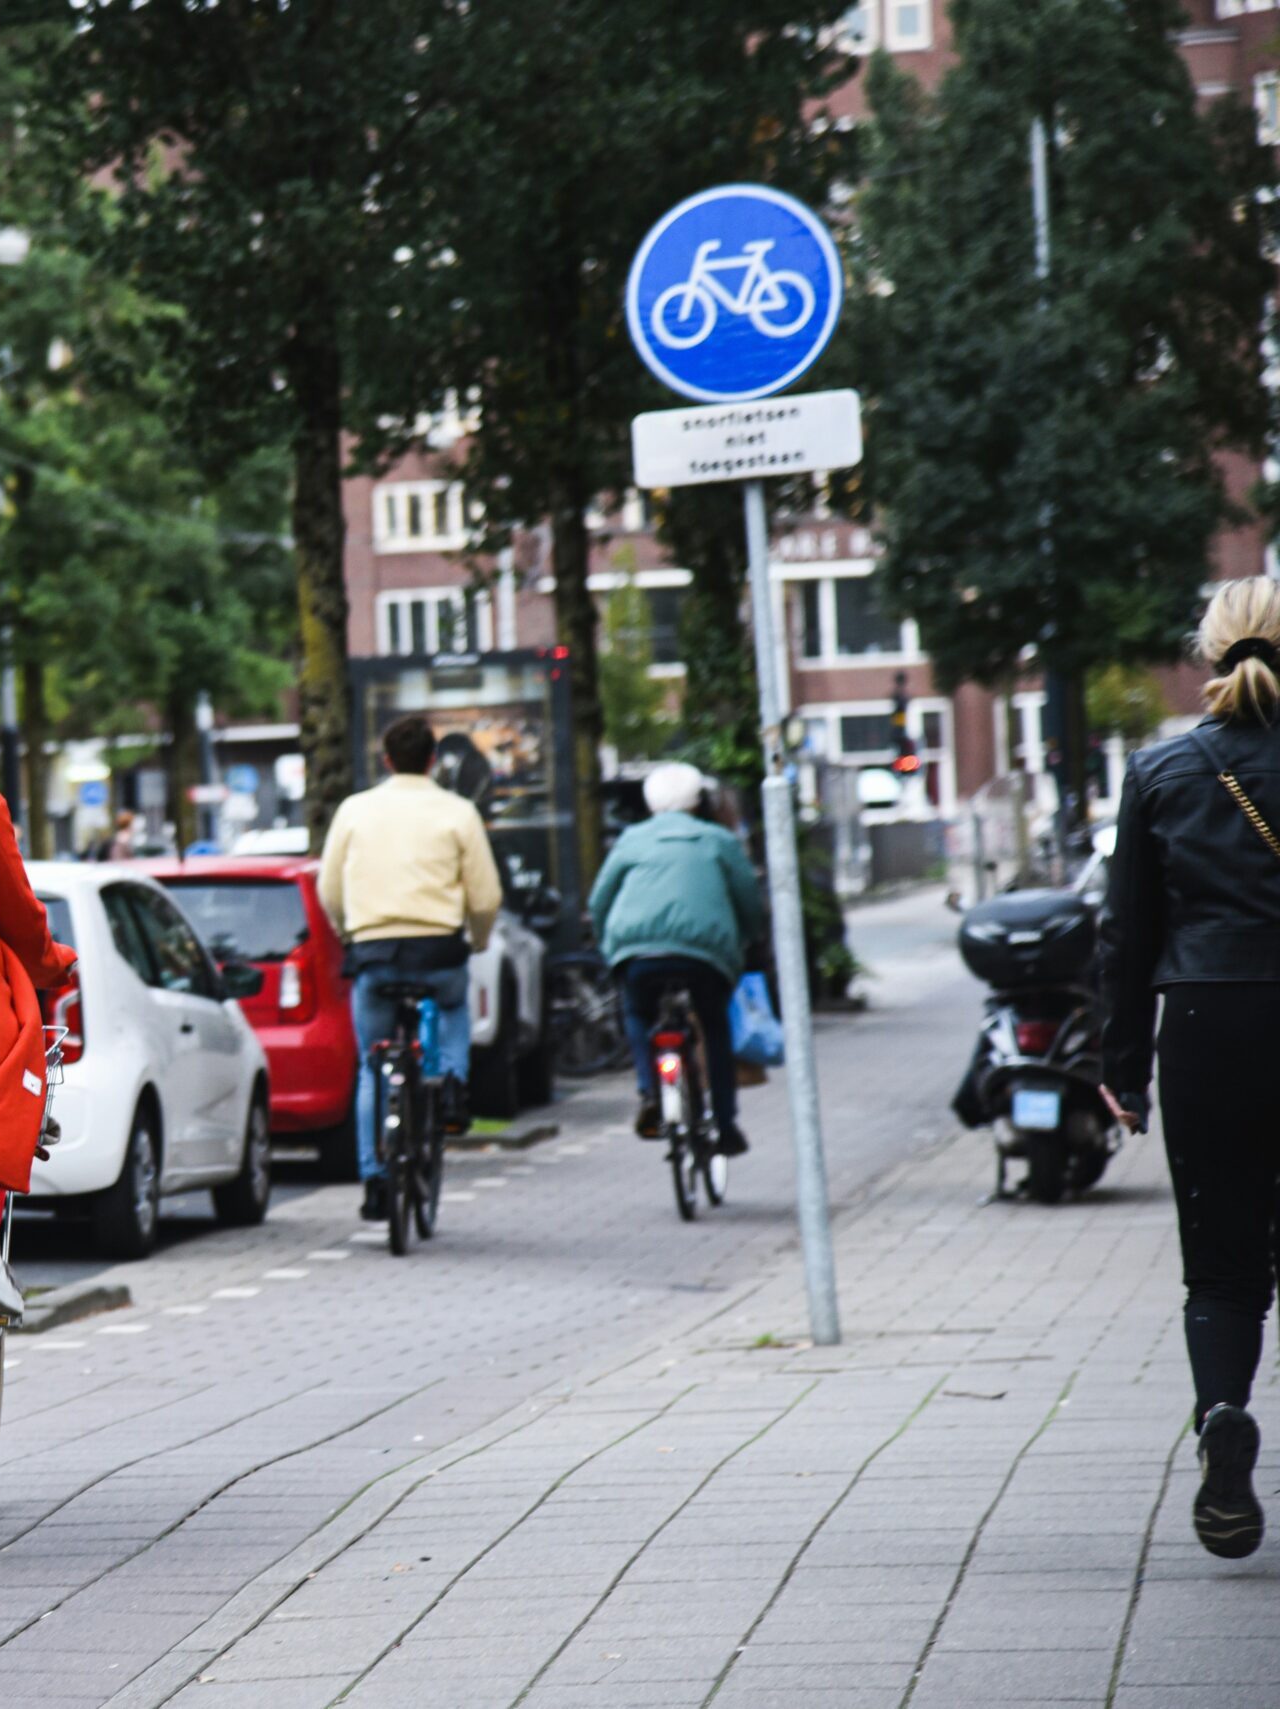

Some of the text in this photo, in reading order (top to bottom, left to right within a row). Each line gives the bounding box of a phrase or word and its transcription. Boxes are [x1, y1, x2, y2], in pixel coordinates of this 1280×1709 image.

[683, 408, 799, 431] snorfietsen
[725, 431, 766, 448] niet
[690, 451, 804, 475] toegestaan
